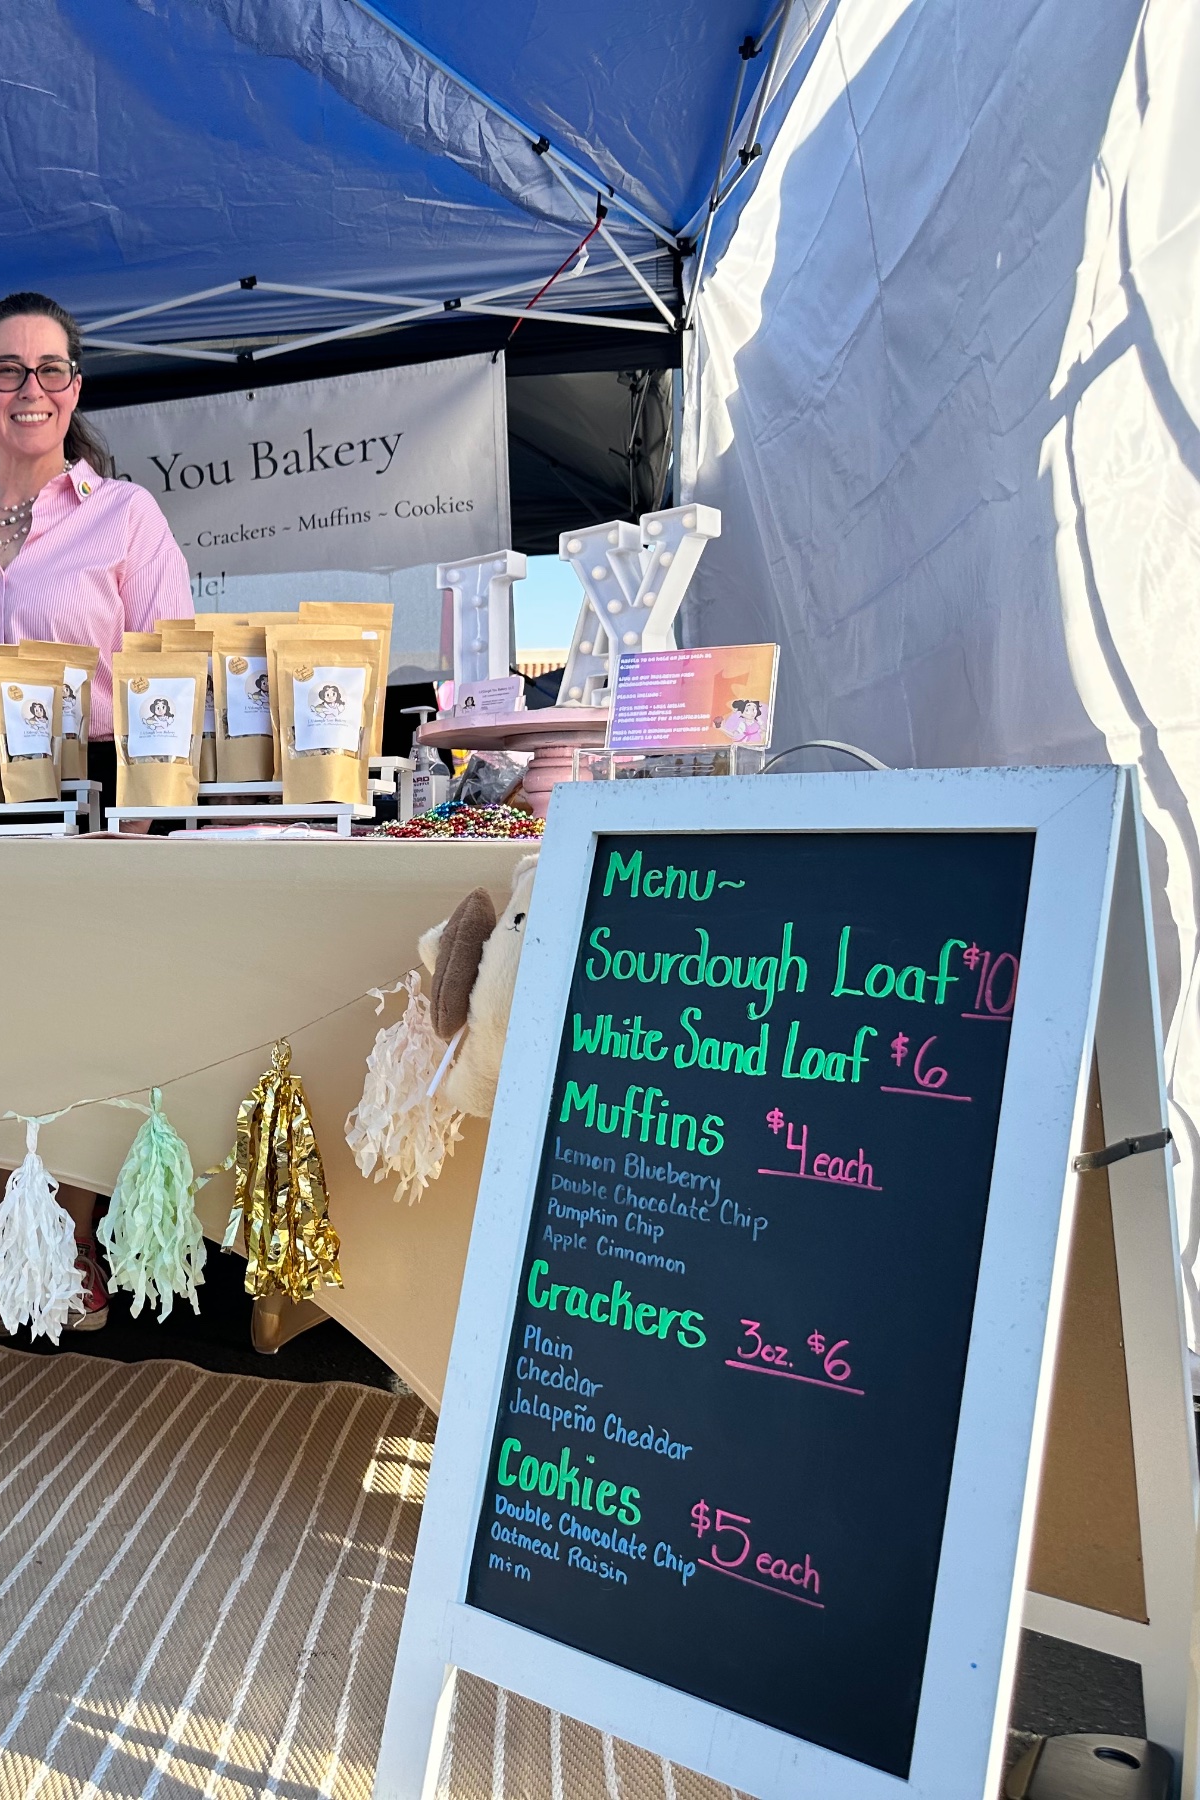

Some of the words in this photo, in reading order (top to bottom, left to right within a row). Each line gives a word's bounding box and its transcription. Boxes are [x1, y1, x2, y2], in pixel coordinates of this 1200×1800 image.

[147, 452, 236, 494] You
[248, 427, 405, 481] Bakery
[197, 523, 276, 549] Crackers
[298, 506, 371, 533] Muffins
[394, 495, 474, 519] Cookies
[585, 921, 808, 1021] Sourdough
[831, 925, 967, 1005] Loaf
[962, 941, 1019, 1014] $10
[572, 1012, 668, 1061] White
[675, 1007, 769, 1077] Sand
[782, 1020, 878, 1083] Loaf
[890, 1031, 949, 1089] $6
[559, 1081, 725, 1156] Muffins
[766, 1107, 808, 1175] $4
[813, 1148, 874, 1187] each
[554, 1135, 616, 1174] Lemon
[624, 1152, 721, 1207] Blueberry
[548, 1197, 618, 1229] Pumpkin
[624, 1212, 665, 1244] Chip
[551, 1174, 608, 1200] Double
[614, 1184, 711, 1223] Chocolate
[719, 1199, 769, 1241] Chip
[542, 1225, 587, 1251] Apple
[596, 1236, 686, 1275] Cinnamon
[523, 1324, 574, 1361] Plain
[527, 1259, 707, 1349] Crackers
[806, 1328, 852, 1381] $6
[516, 1356, 604, 1398] Cheddar
[509, 1387, 596, 1434] Jalapeño
[603, 1413, 693, 1461] Cheddar
[495, 1493, 553, 1532] Double
[559, 1513, 648, 1561] Chocolate
[653, 1541, 696, 1587] Chip
[497, 1437, 642, 1526] Cookies
[690, 1498, 751, 1568] $5
[756, 1553, 820, 1595] each
[491, 1521, 560, 1561] Oatmeal
[568, 1545, 628, 1585] Raisin
